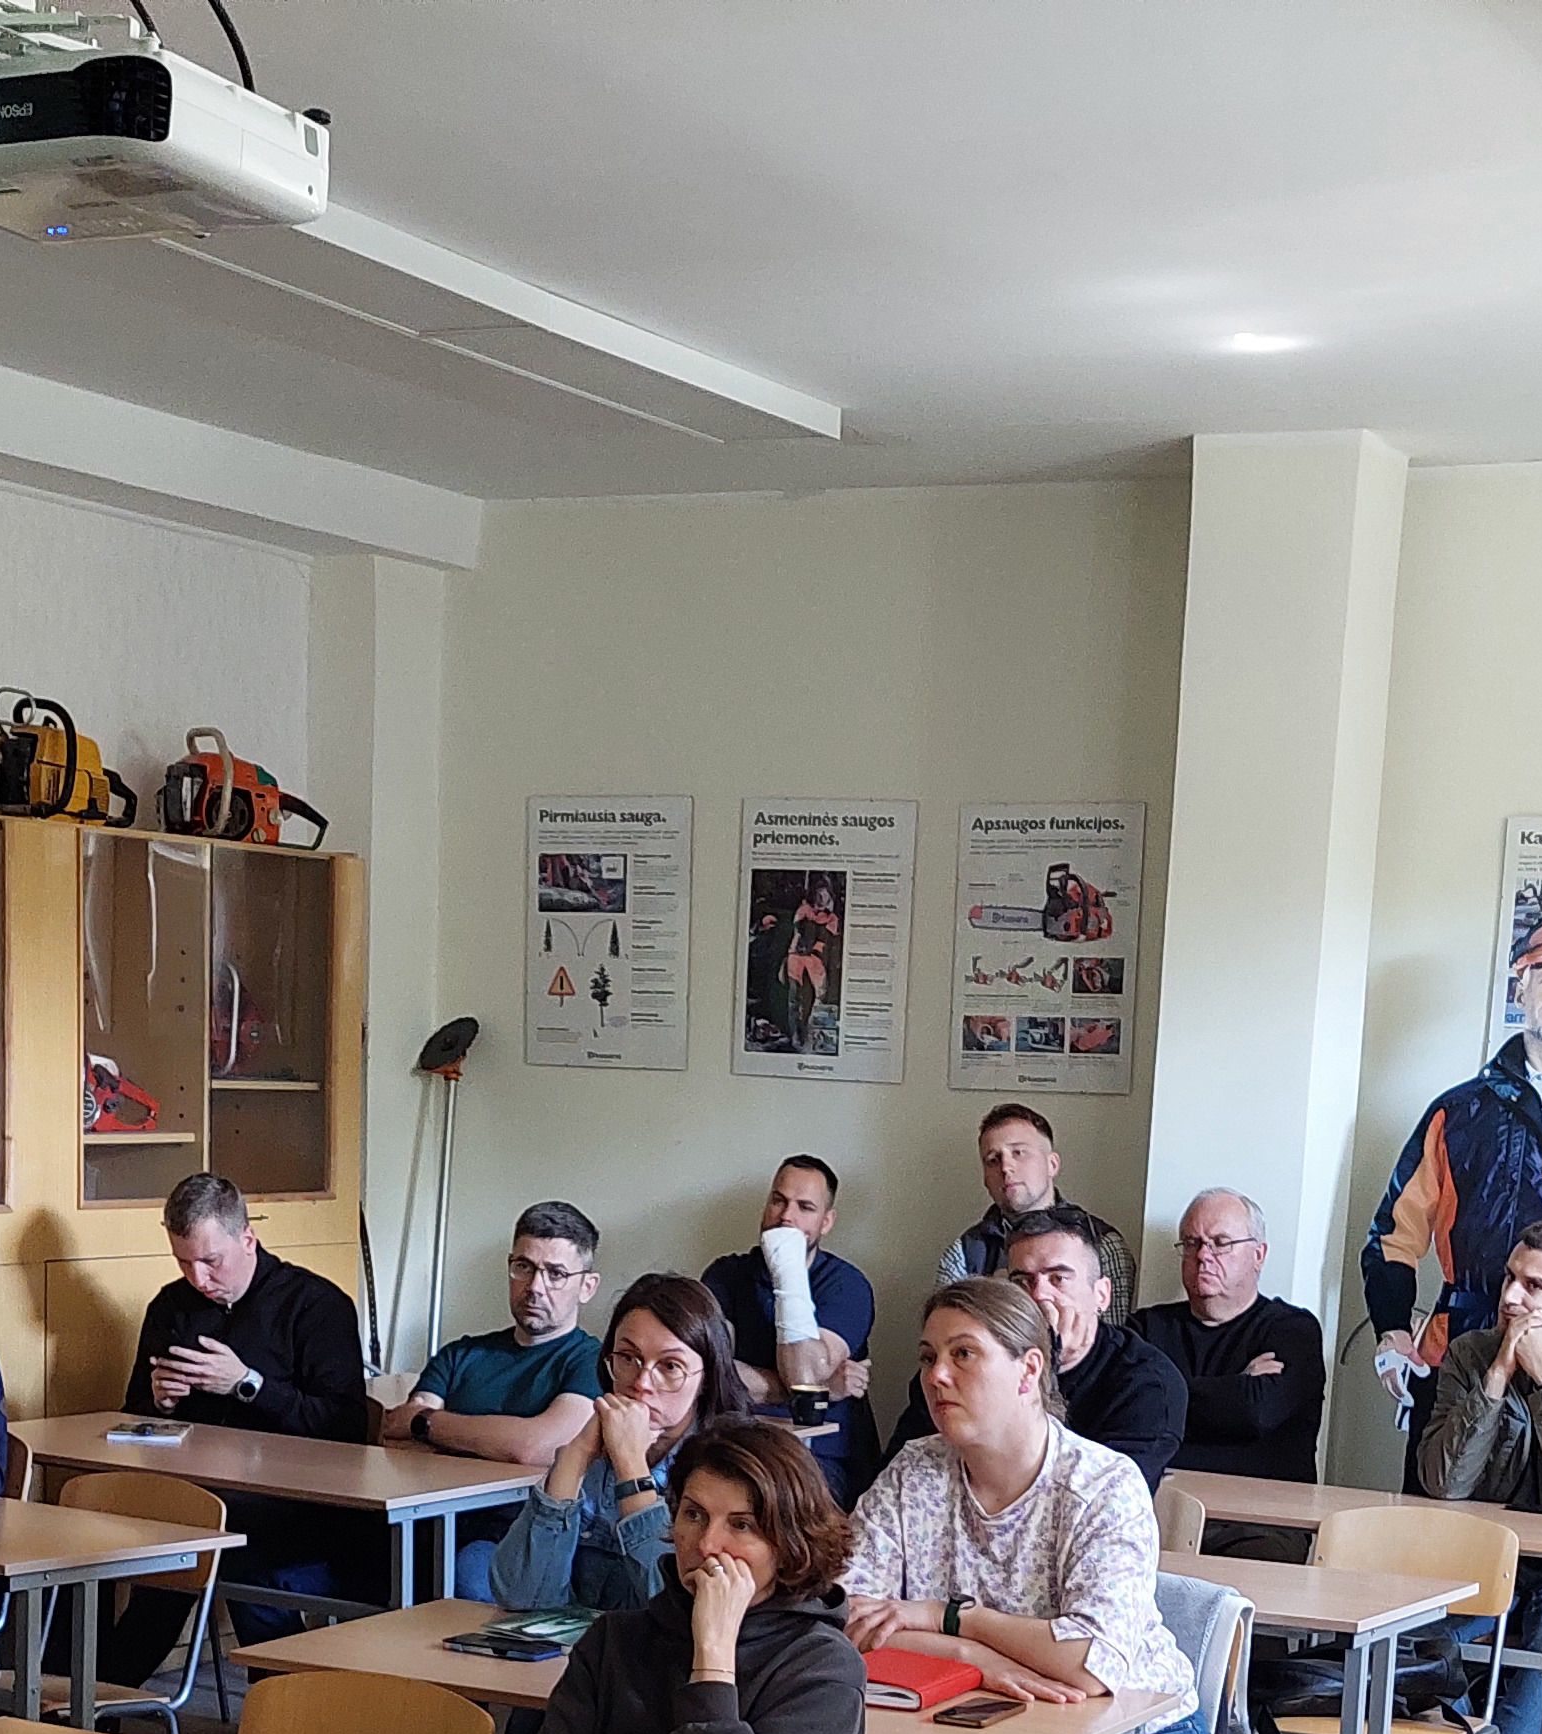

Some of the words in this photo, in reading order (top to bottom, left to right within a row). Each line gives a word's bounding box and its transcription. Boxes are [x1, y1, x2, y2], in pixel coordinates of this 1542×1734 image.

[538, 809, 617, 823] Pirmiausia
[619, 811, 667, 827] sauga.
[754, 811, 839, 828] Asmeninės
[841, 814, 895, 832] saugos
[971, 817, 1046, 835] Apsaugos
[1049, 815, 1126, 834] funkcijos.
[752, 829, 840, 849] priemonės.
